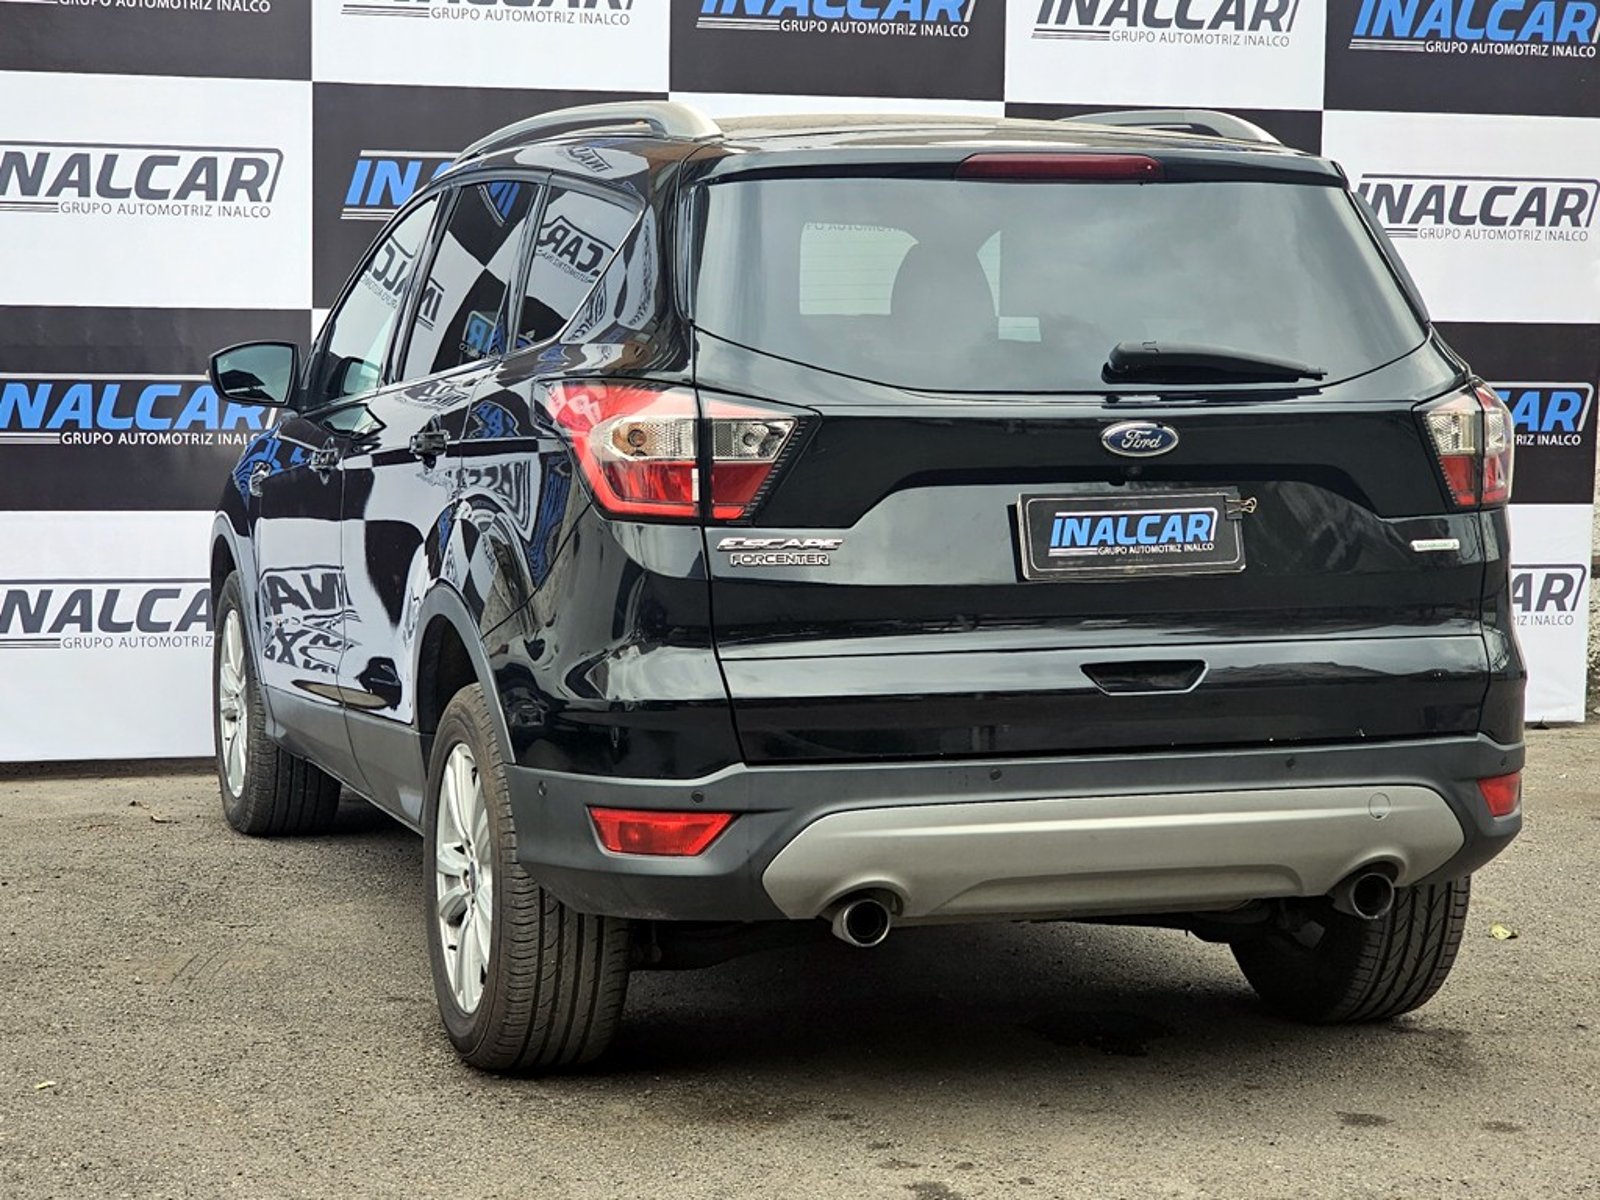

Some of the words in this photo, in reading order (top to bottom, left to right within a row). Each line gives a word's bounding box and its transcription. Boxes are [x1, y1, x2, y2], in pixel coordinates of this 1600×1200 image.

[216, 0, 271, 13] INALCO
[431, 7, 480, 20] GRUPO
[485, 9, 575, 24] AUTOMOTRIZ
[579, 13, 630, 25] INALCO
[1353, 0, 1597, 44] INALCAR
[780, 19, 827, 32] GRUPO
[831, 21, 916, 35] AUTOMOTRIZ
[920, 24, 969, 37] INALCO
[1111, 30, 1156, 42] GRUPO
[1159, 32, 1240, 45] AUTOMOTRIZ
[1244, 35, 1289, 47] INALCO
[1425, 40, 1468, 54] GRUPO
[1471, 42, 1548, 56] AUTOMOTRIZ
[1552, 45, 1596, 57] INALCO
[0, 151, 269, 202] NALCAR
[60, 201, 112, 215] GRUPO
[117, 202, 213, 217] AUTOMOTRIZ
[217, 205, 271, 218] INALCO
[1419, 228, 1461, 240] GRUPO
[1464, 229, 1541, 241] AUTOMOTRIZ
[1545, 230, 1588, 242] INALCO
[0, 383, 265, 430] NALCAR
[62, 431, 113, 445] GRUPO
[118, 431, 213, 445] AUTOMOTRIZ
[1121, 429, 1162, 448] Ford
[1537, 434, 1581, 446] INALCO
[1050, 513, 1211, 547] INALCAR
[717, 537, 843, 551] ESCAPE
[1098, 545, 1128, 556] GRUPO
[1129, 543, 1182, 555] AUTOMOTRIZ
[1184, 542, 1215, 553] INALCO
[730, 553, 831, 567] FORCENTER
[1531, 614, 1574, 626] INALCO
[62, 636, 113, 649] GRUPO
[118, 636, 213, 649] AUTOMOTRIZ
